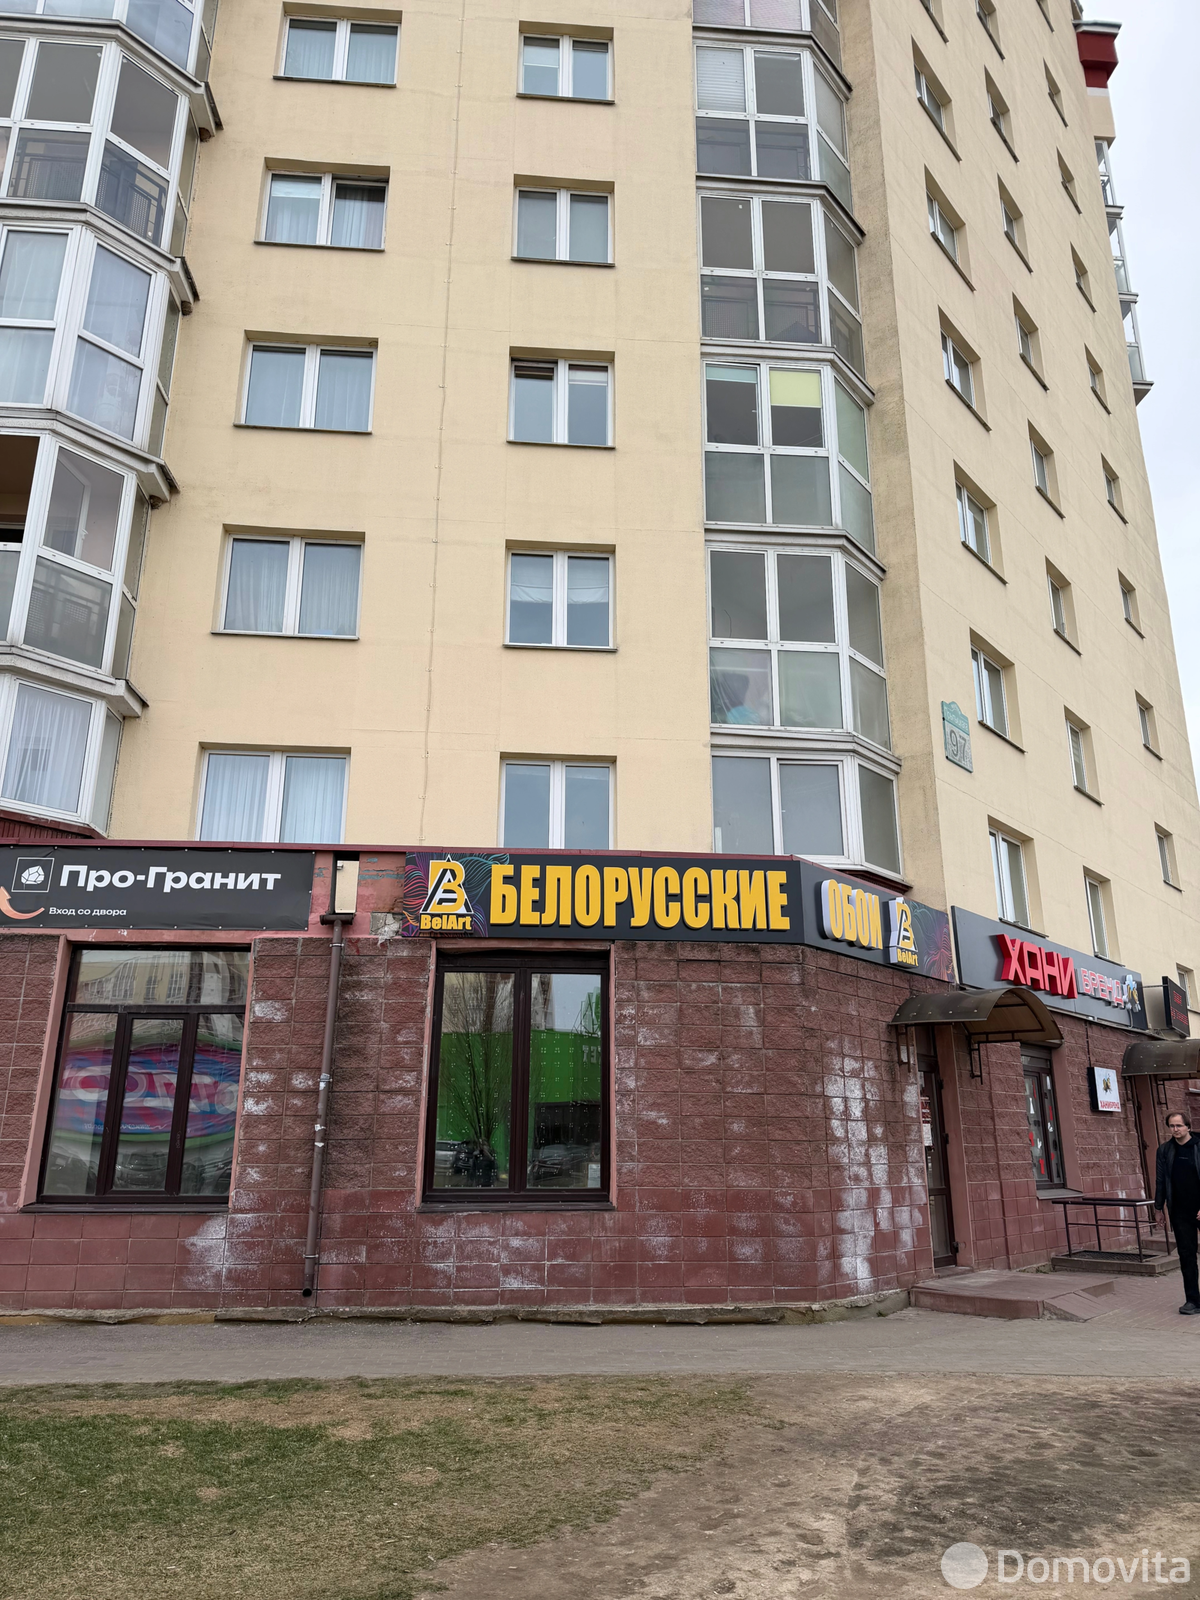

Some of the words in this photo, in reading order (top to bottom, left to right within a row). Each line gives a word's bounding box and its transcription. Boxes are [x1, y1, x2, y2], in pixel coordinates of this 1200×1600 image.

[949, 729, 966, 761] 97
[59, 864, 282, 893] Про-Гранит
[48, 906, 76, 916] Вход
[77, 908, 91, 917] со
[92, 909, 127, 917] двора
[489, 863, 791, 931] БЕЛОРУССКИЕ
[420, 912, 472, 932] BelArt
[820, 878, 883, 950] ОБОИ
[897, 948, 919, 967] BelArt
[996, 933, 1078, 999] ХАНИ
[1080, 967, 1124, 1008] БРЕНД
